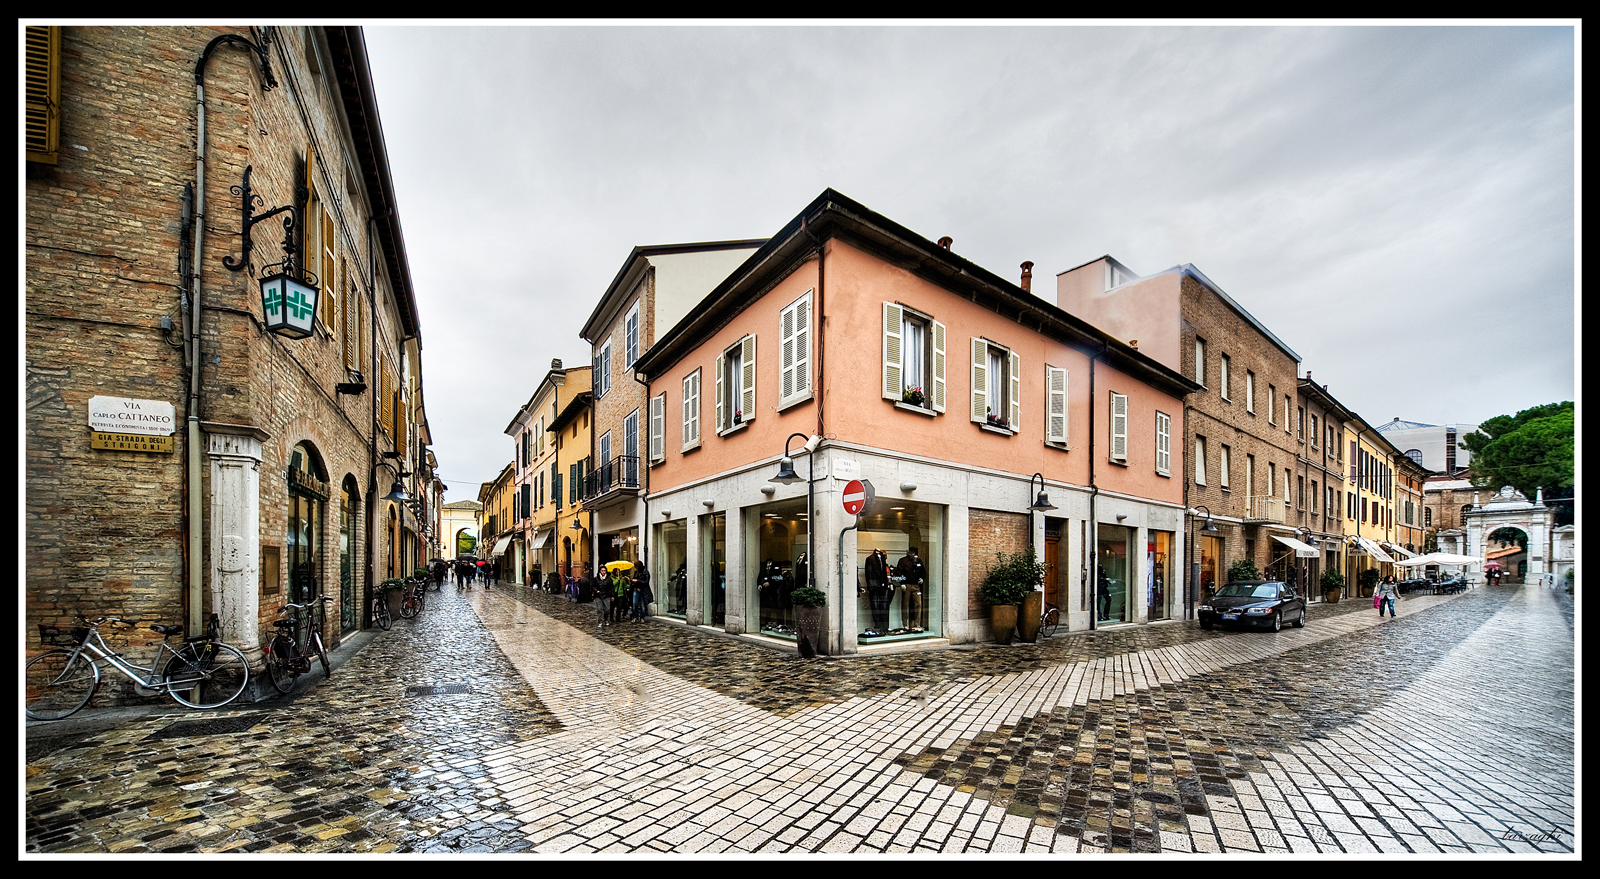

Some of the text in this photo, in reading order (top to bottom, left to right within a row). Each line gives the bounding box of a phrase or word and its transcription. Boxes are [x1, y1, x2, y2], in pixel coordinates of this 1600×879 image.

[123, 401, 141, 410] VIA
[118, 412, 171, 423] CATTANEO
[116, 435, 145, 443] STRADA
[104, 441, 160, 450] STRIGONI
